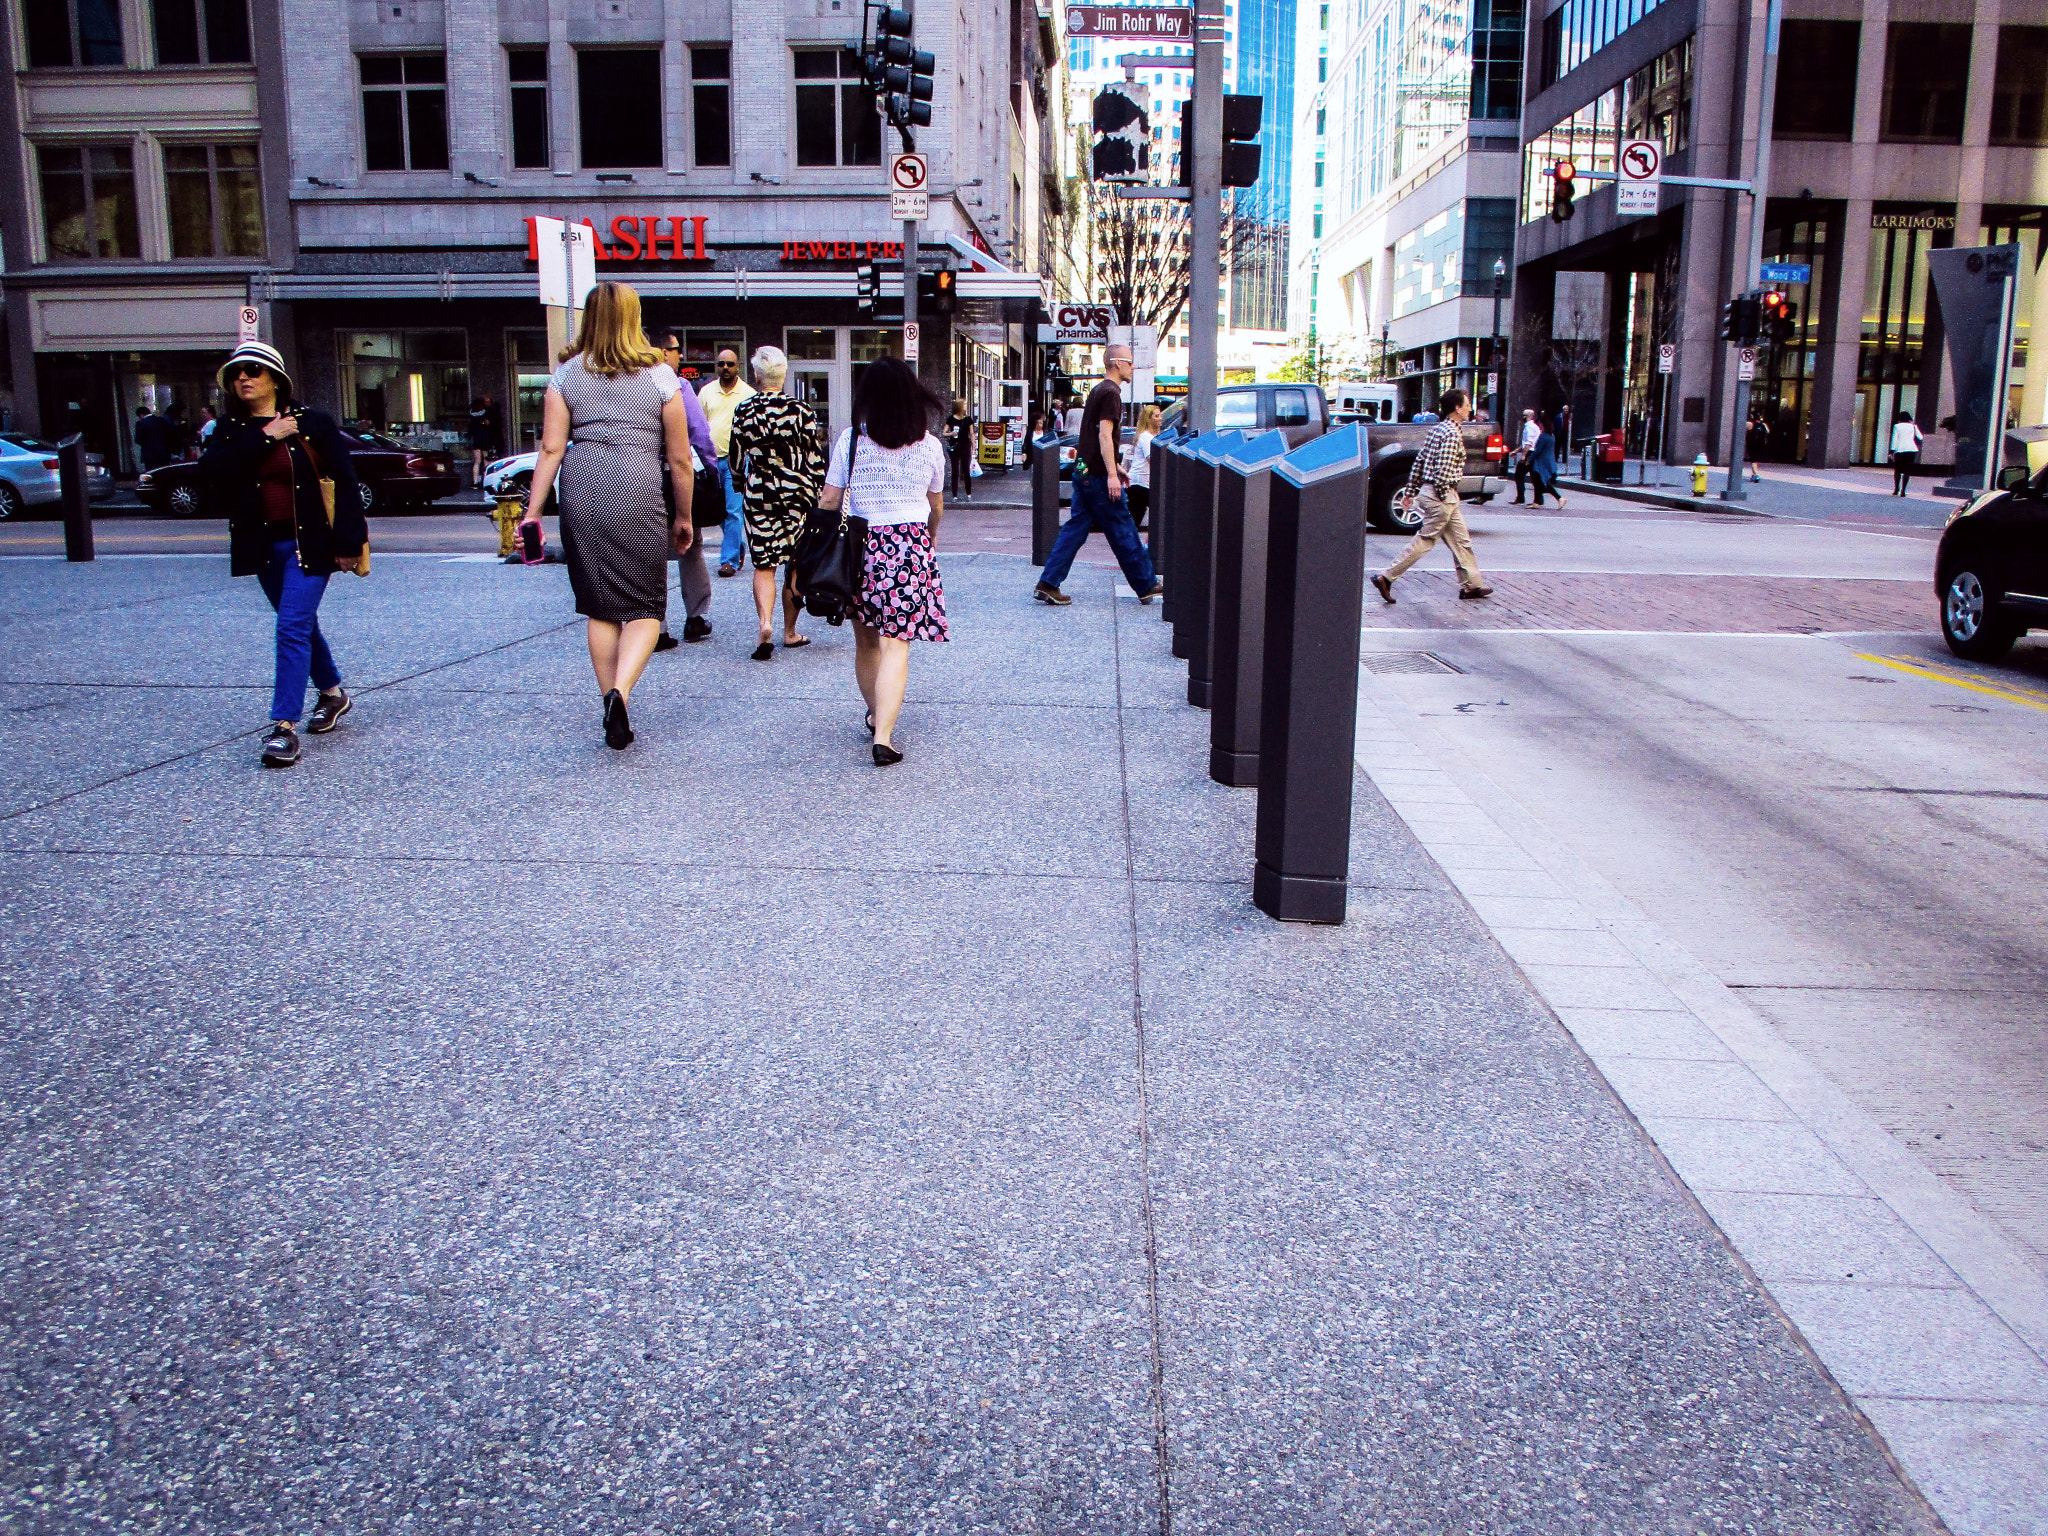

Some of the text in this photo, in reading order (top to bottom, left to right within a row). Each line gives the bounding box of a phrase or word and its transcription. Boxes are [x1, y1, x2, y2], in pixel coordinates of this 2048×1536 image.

[1093, 12, 1183, 38] Jim Rohr Way
[1872, 214, 1956, 230] LARRIMOR'S
[779, 240, 905, 260] JEWELER
[1767, 269, 1802, 281] Wood St
[1058, 307, 1111, 328] CVS
[1056, 327, 1108, 341] pharmac
